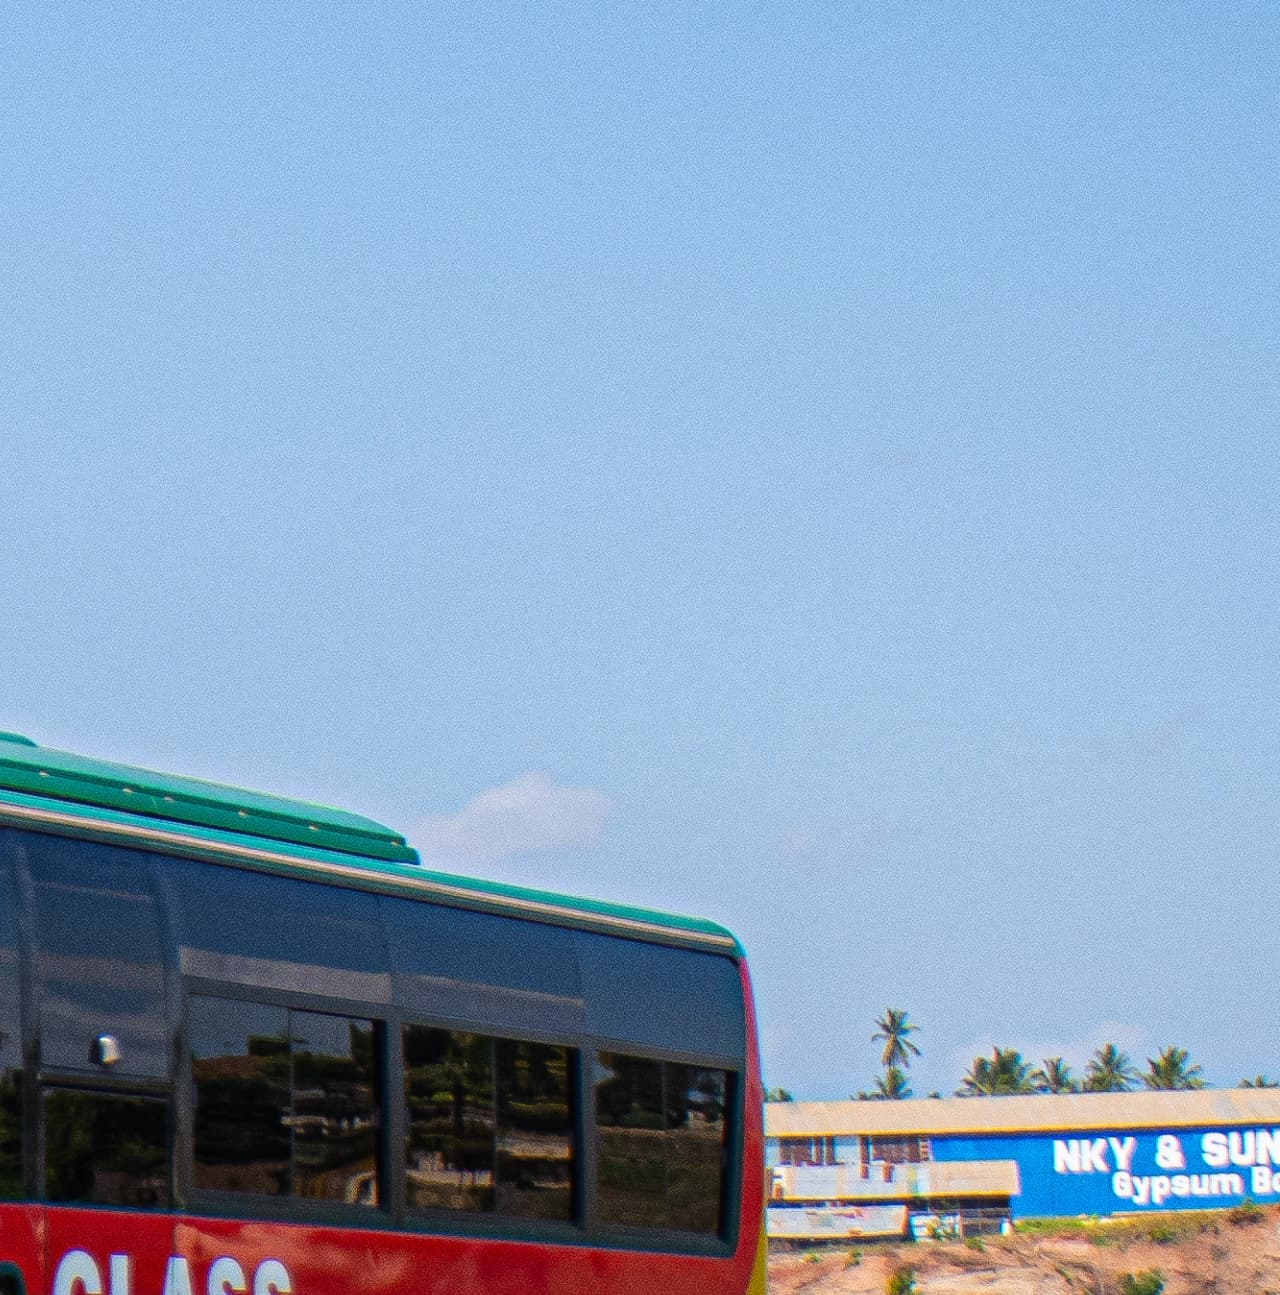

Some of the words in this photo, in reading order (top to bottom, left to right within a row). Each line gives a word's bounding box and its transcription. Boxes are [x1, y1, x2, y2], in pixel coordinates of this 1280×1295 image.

[1053, 1136, 1136, 1173] NKY
[1155, 1134, 1186, 1169] &
[1112, 1170, 1244, 1205] Gypsum
